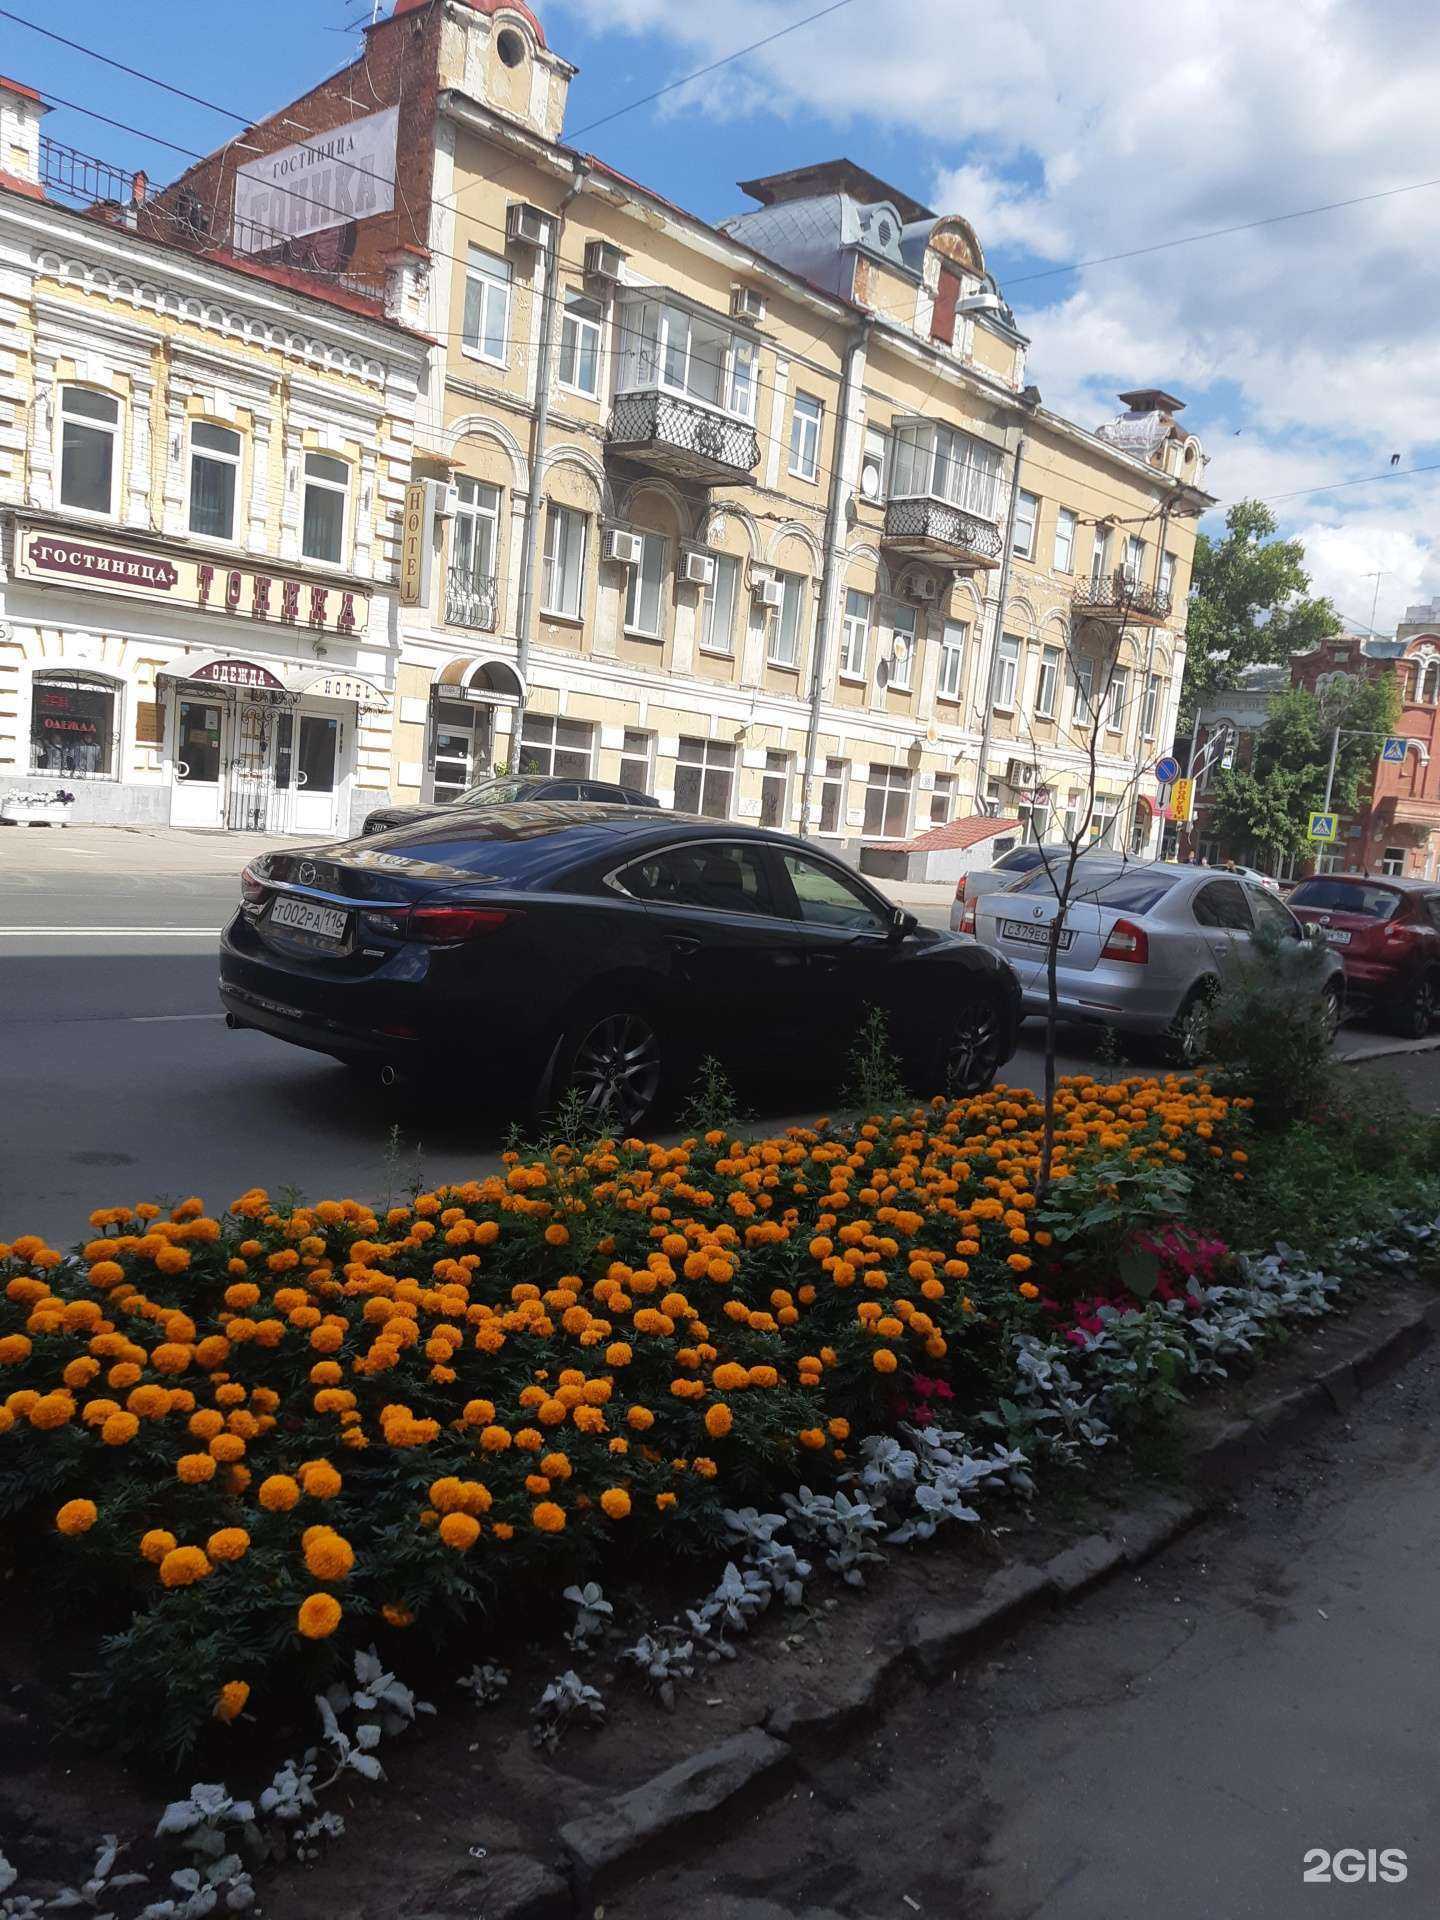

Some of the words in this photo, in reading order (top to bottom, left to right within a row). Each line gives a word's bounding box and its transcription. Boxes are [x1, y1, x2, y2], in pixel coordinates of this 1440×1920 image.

[273, 136, 354, 179] ГОСТИНИЦА
[406, 491, 421, 599] HOTEL
[41, 546, 168, 587] ГОСТИНИЦА
[199, 565, 356, 626] ТОНИКА
[212, 664, 266, 686] ОДЕЖДА
[325, 680, 371, 698] HOTEL
